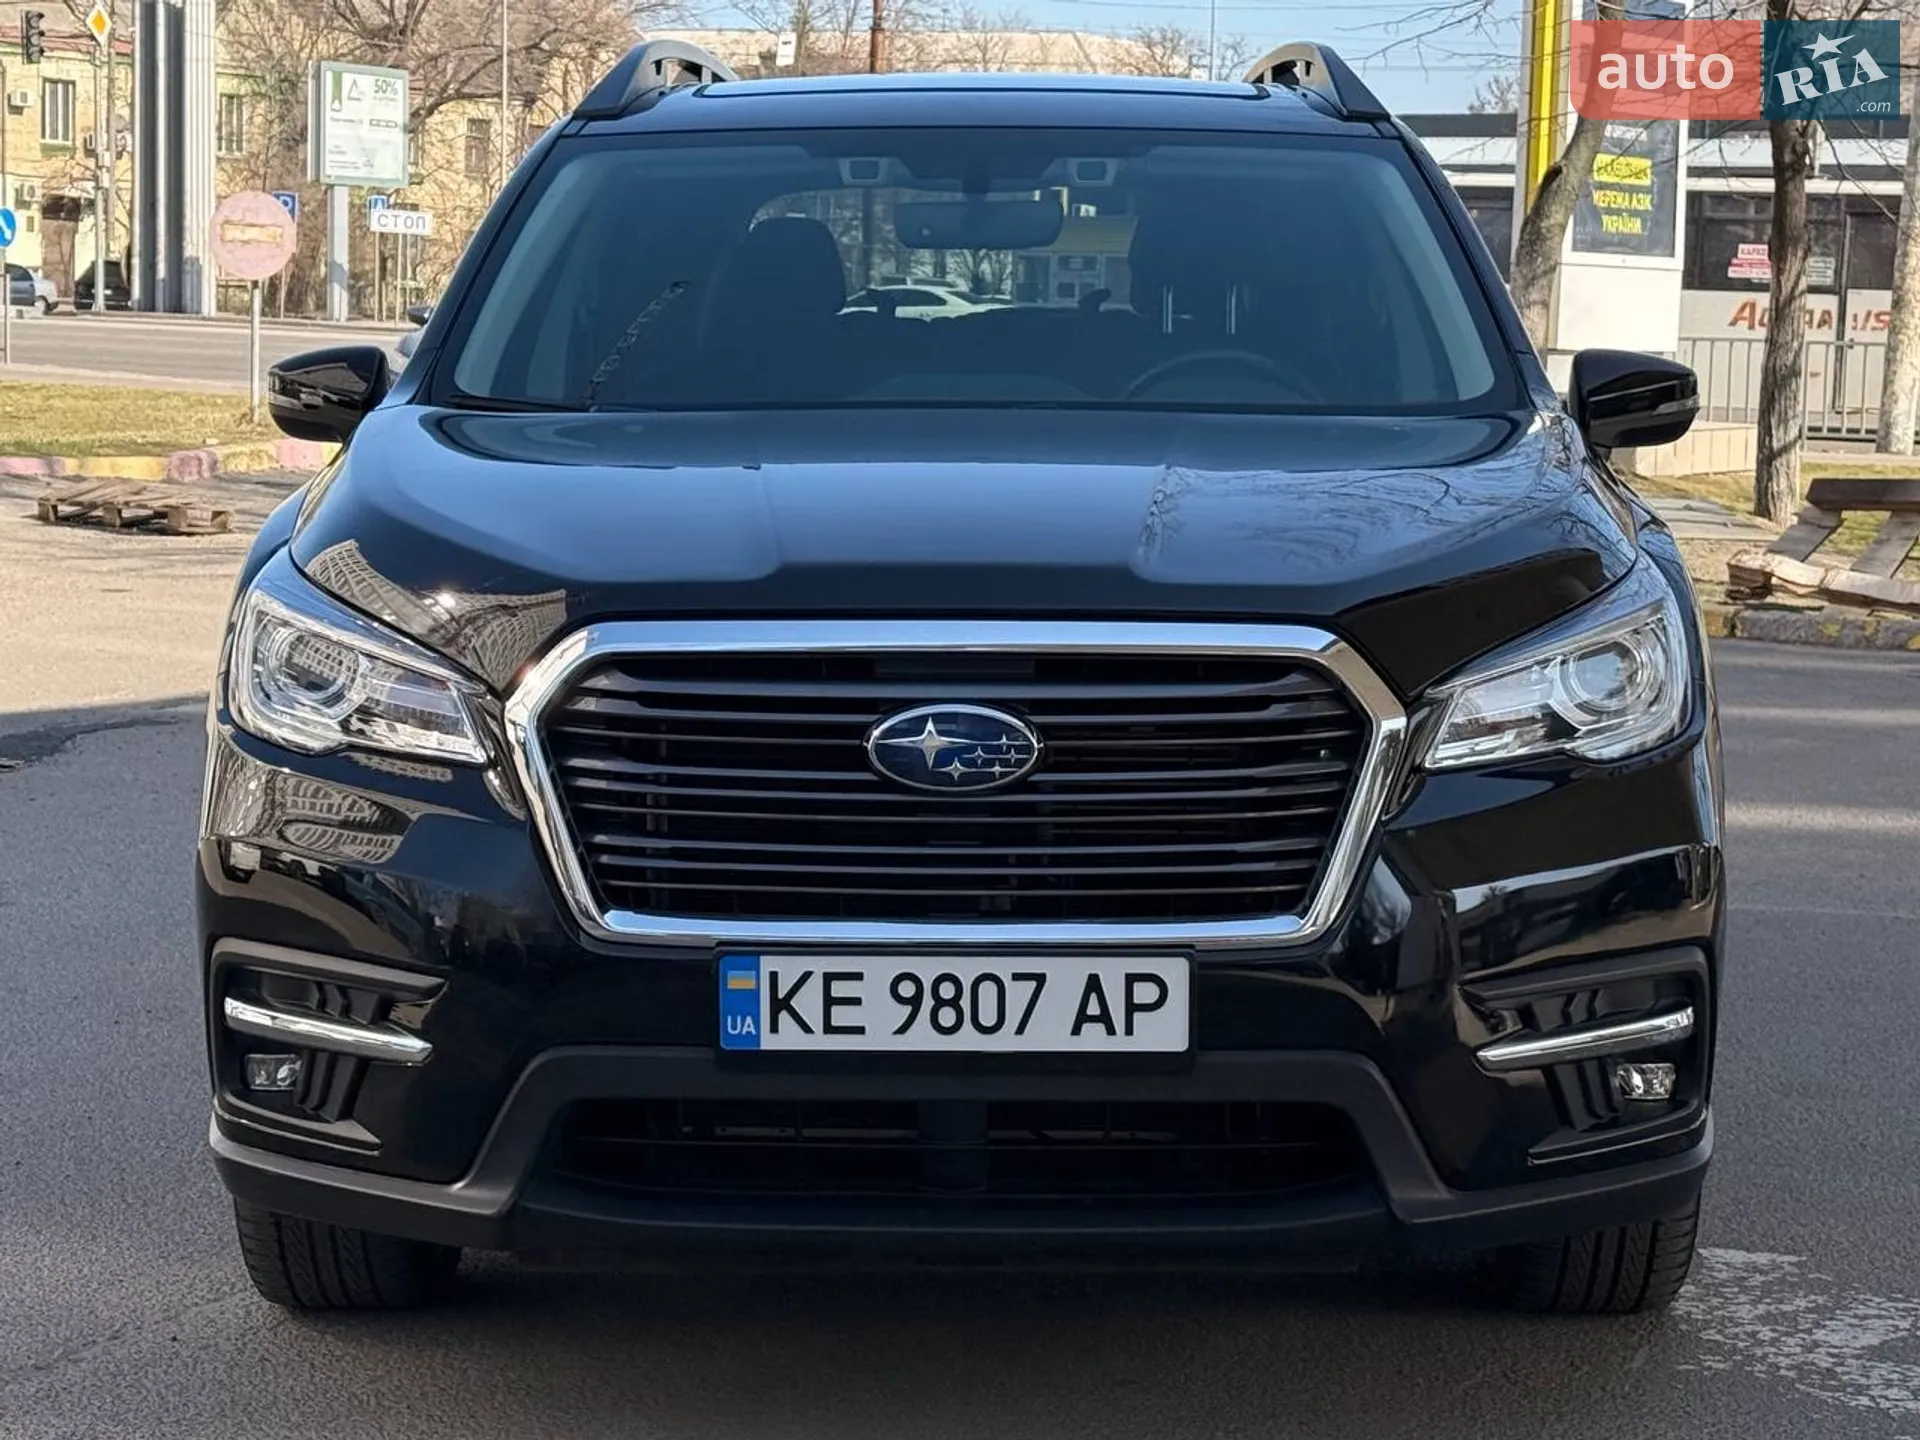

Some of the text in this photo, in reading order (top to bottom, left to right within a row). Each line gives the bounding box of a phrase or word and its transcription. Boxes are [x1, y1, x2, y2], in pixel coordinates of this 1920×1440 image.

[374, 78, 399, 96] 50%
[377, 213, 426, 231] СТОП
[768, 970, 1169, 1037] KE 9807 AP
[727, 1015, 757, 1035] UA
